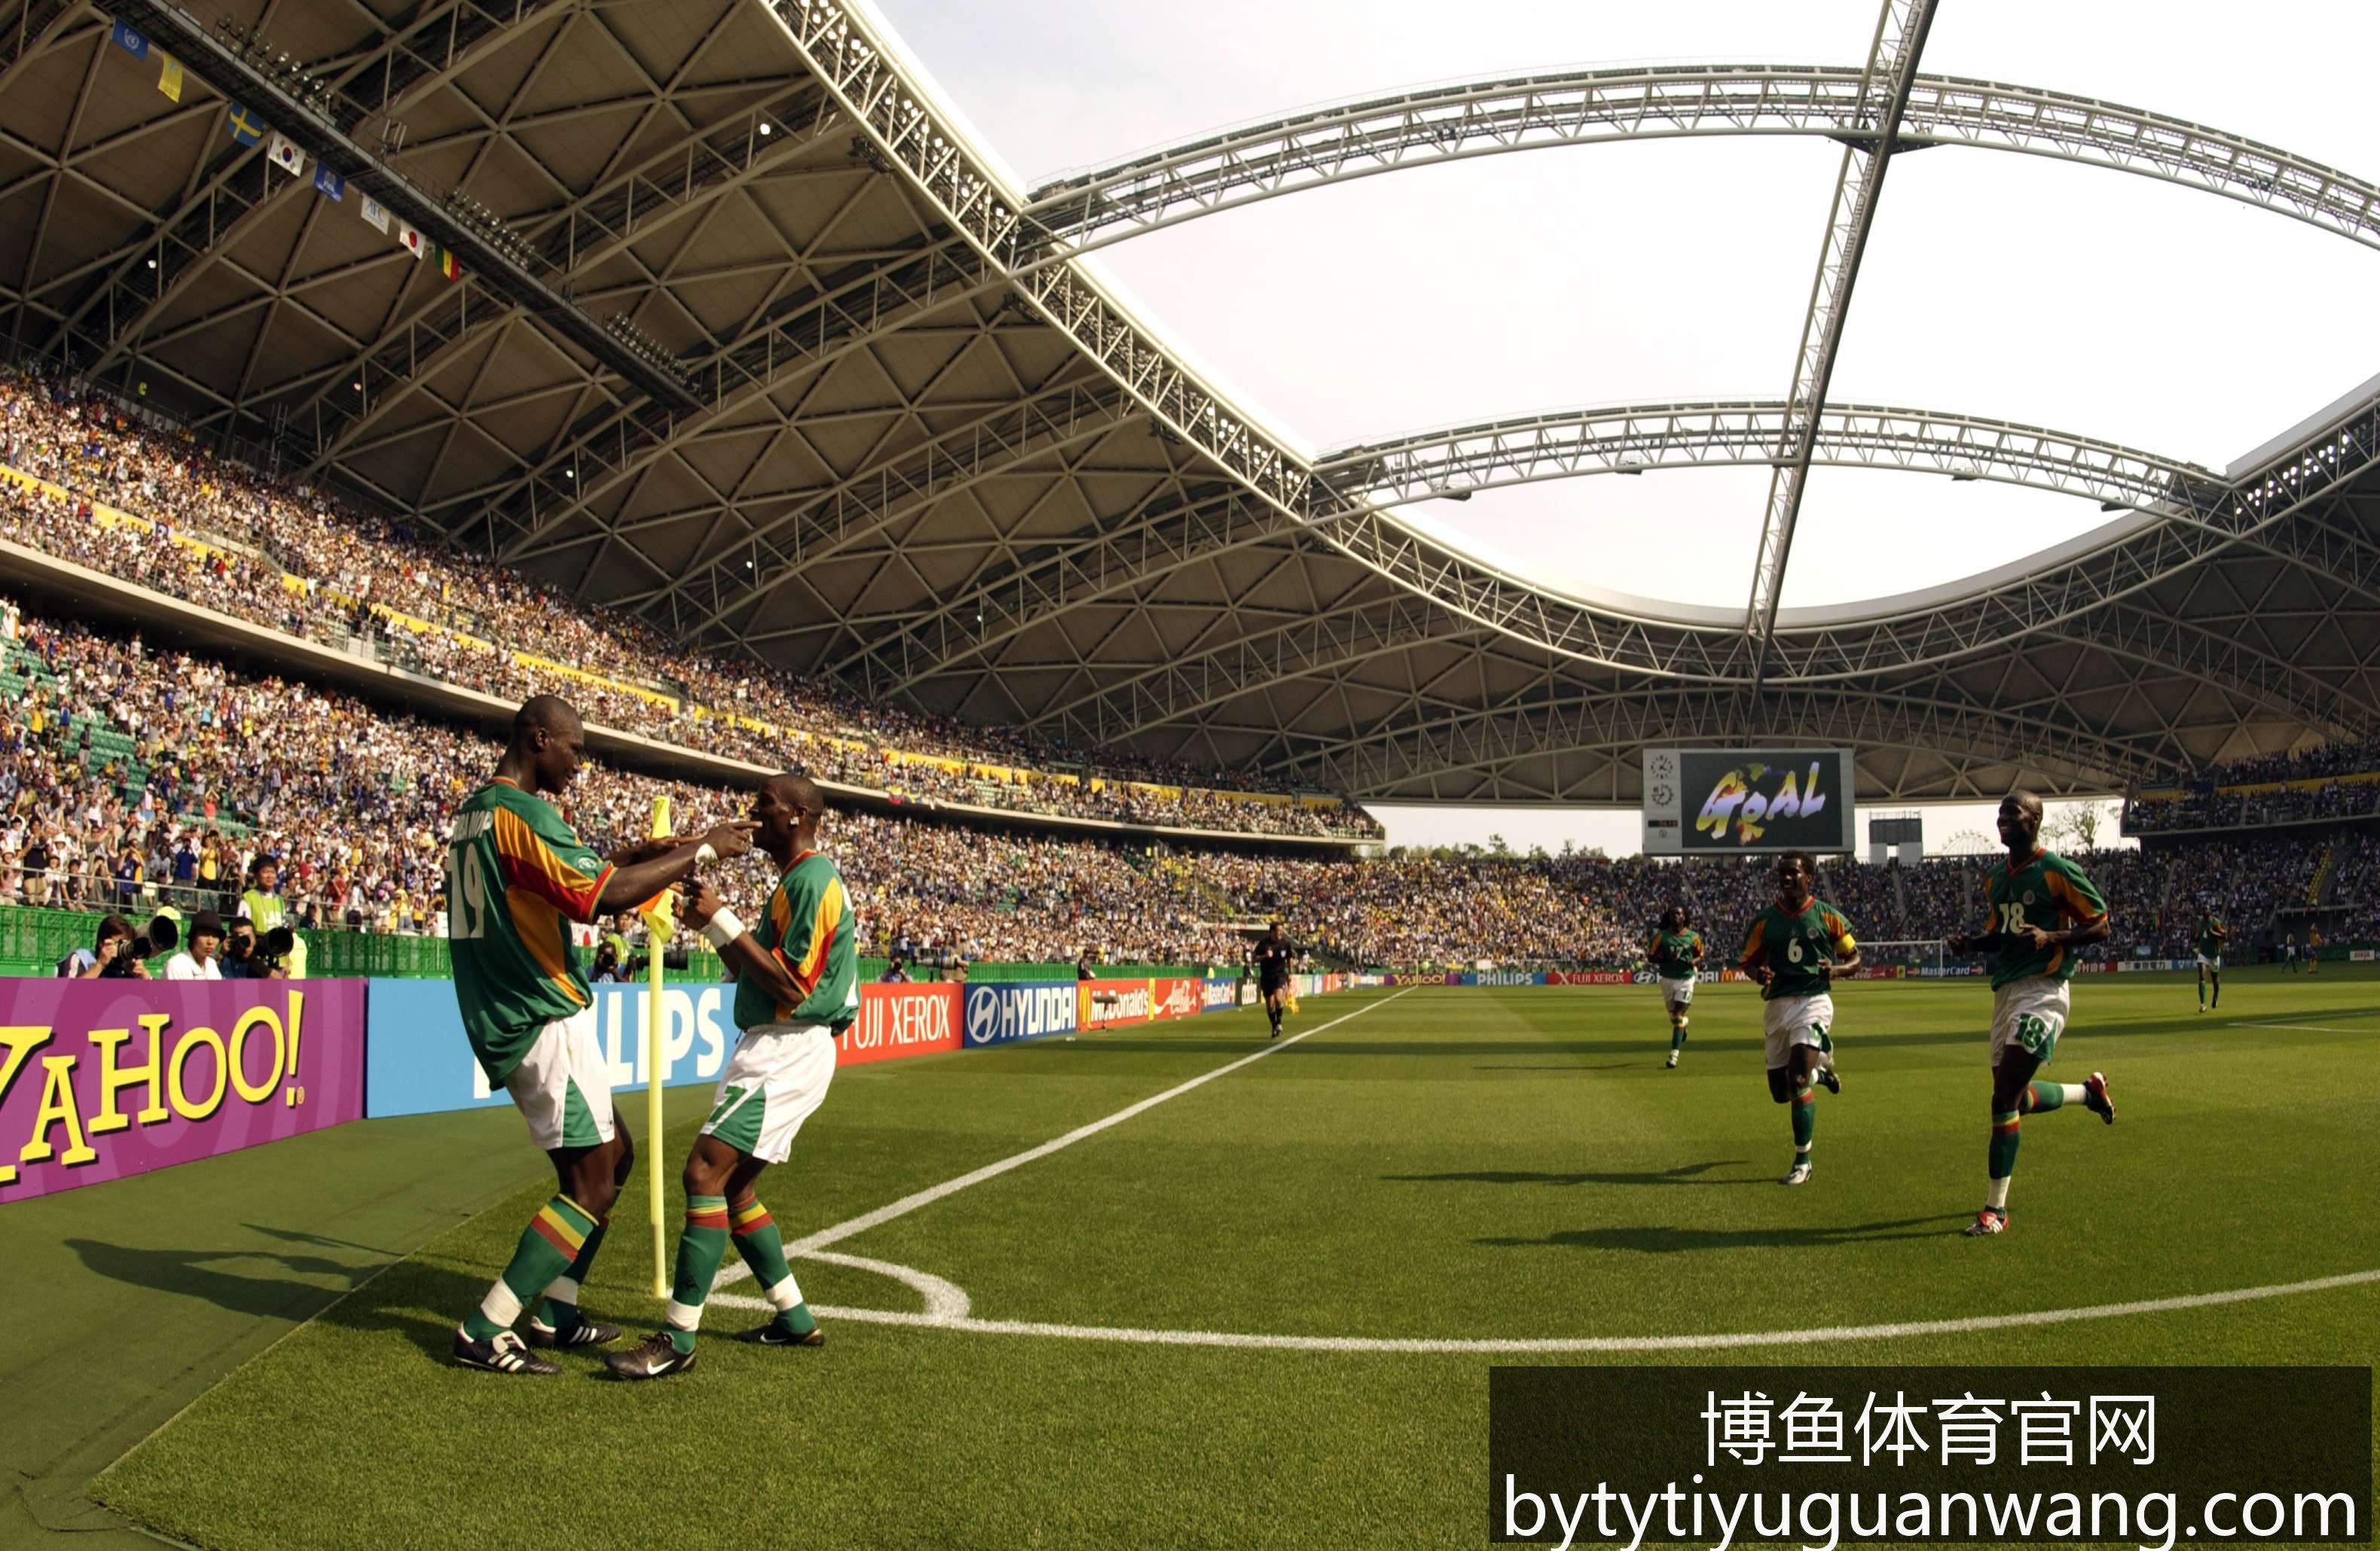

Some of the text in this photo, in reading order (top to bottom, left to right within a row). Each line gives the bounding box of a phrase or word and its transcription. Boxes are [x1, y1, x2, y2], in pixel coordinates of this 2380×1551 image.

[446, 842, 485, 939] 19
[1999, 902, 2025, 934] 18
[1787, 938, 1803, 964] 6
[1477, 972, 1533, 986] PHILIPS
[1593, 972, 1625, 984] XEROX
[1921, 966, 1970, 976] MasterCard
[889, 994, 951, 1046] XEROX
[1001, 986, 1077, 1039] HYUNDAI
[2015, 1013, 2046, 1049] 18
[707, 1084, 748, 1124] 7
